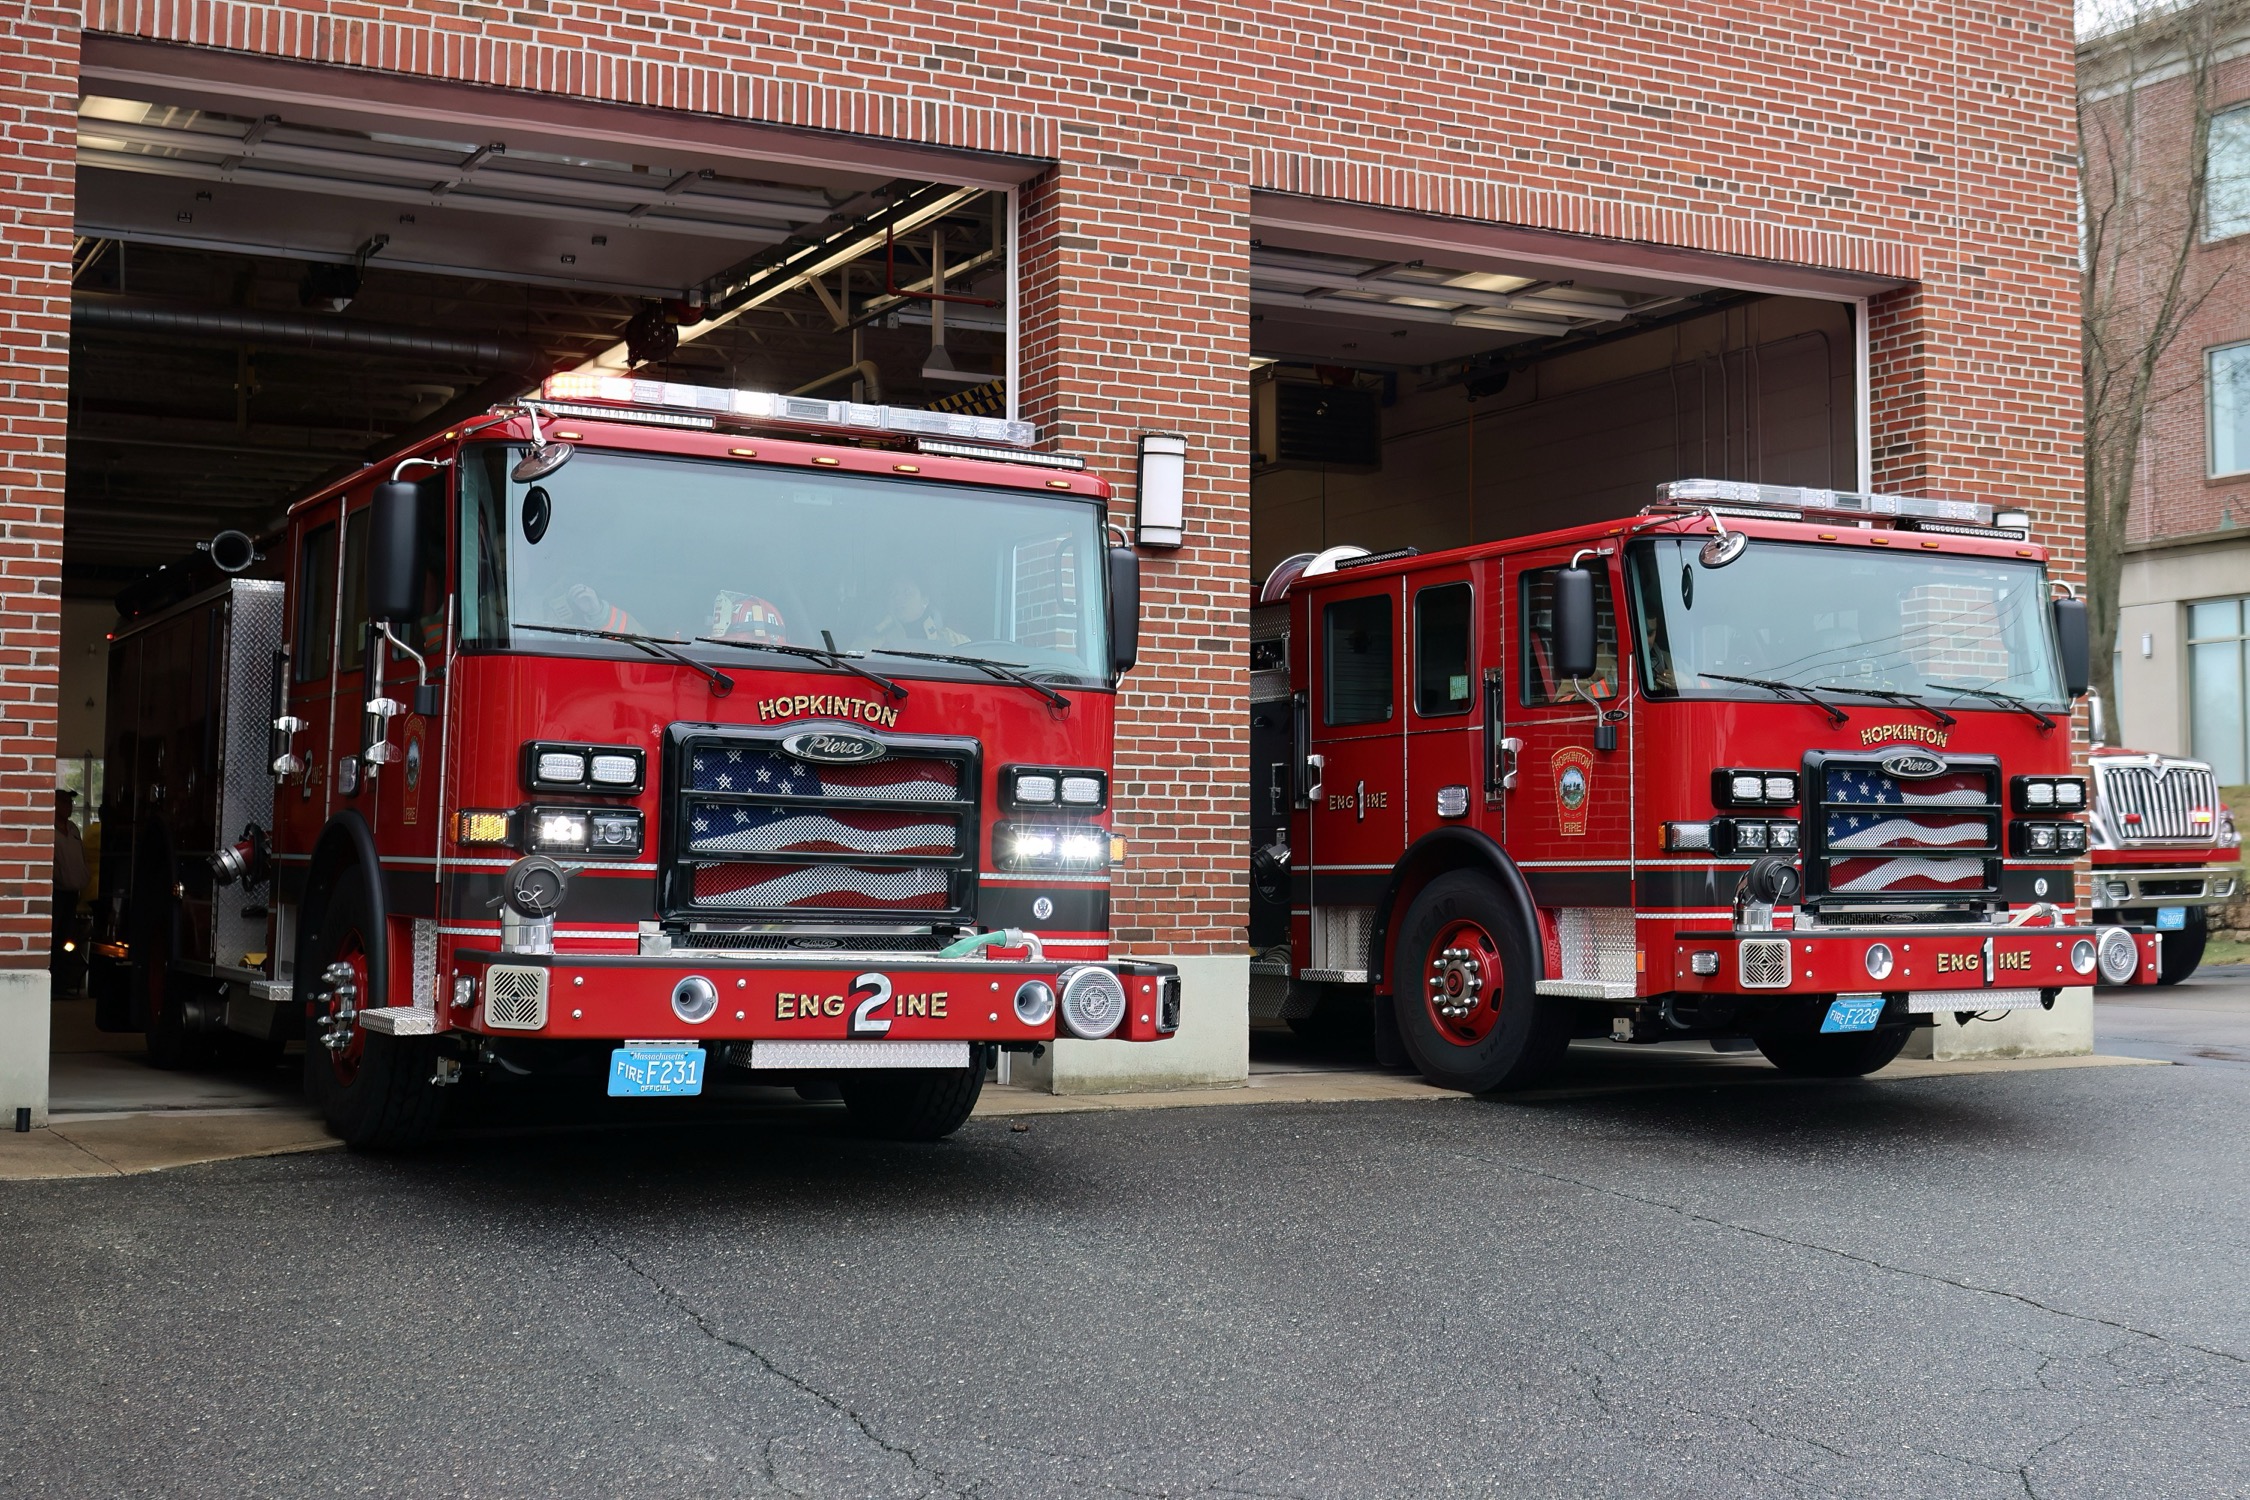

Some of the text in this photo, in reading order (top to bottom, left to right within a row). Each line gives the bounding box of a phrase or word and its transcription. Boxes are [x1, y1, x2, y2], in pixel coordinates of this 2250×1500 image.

[758, 695, 899, 728] HOPKINTON
[806, 734, 865, 755] Pierce
[1860, 724, 1948, 748] HOPKINTON
[1897, 757, 1934, 773] Pierce
[1829, 1007, 1880, 1025] FIRE F228
[633, 1052, 685, 1061] Massachusetts
[617, 1060, 697, 1085] FIRE F231
[640, 1084, 671, 1092] OFFICIAL
